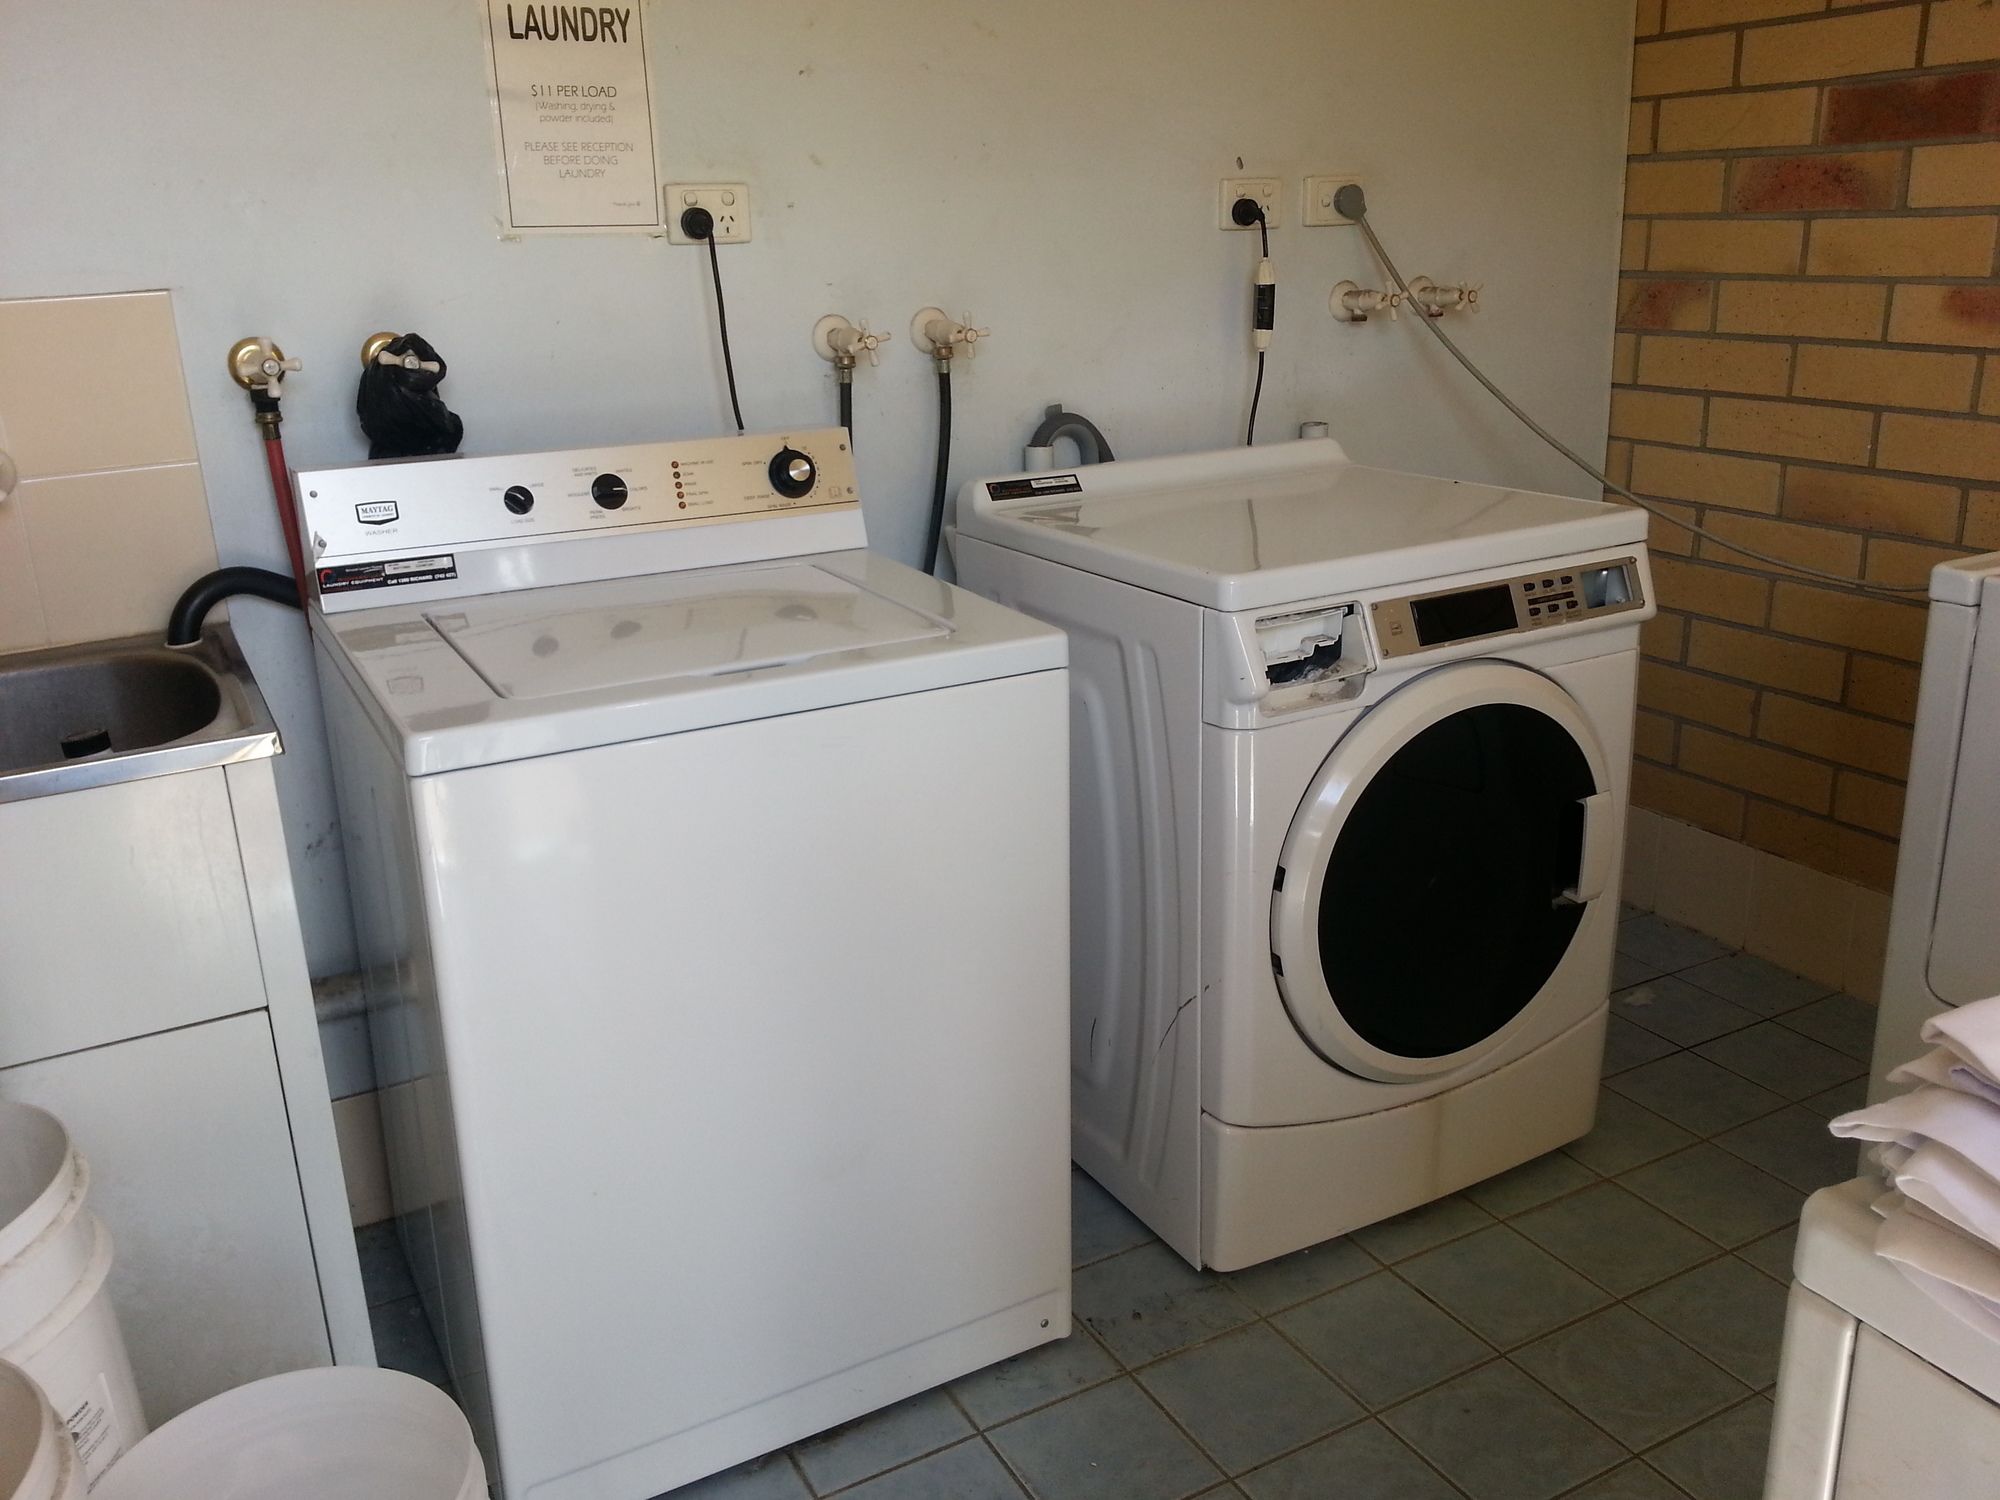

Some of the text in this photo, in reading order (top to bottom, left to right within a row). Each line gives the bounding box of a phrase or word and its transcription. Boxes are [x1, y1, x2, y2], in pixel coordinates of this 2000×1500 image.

[507, 3, 631, 44] LAUNDRY
[531, 84, 618, 98] $11 PER LOAD
[580, 101, 607, 113] drying
[608, 102, 616, 111] &
[539, 114, 573, 123] powder
[524, 141, 634, 152] PLEASE SEE RECEPTION
[543, 155, 618, 166] BEFORE DOING
[559, 168, 606, 178] LAUNDRY
[361, 505, 394, 515] MAYTAG
[365, 528, 398, 537] WASHER
[410, 574, 433, 583] RICHARD
